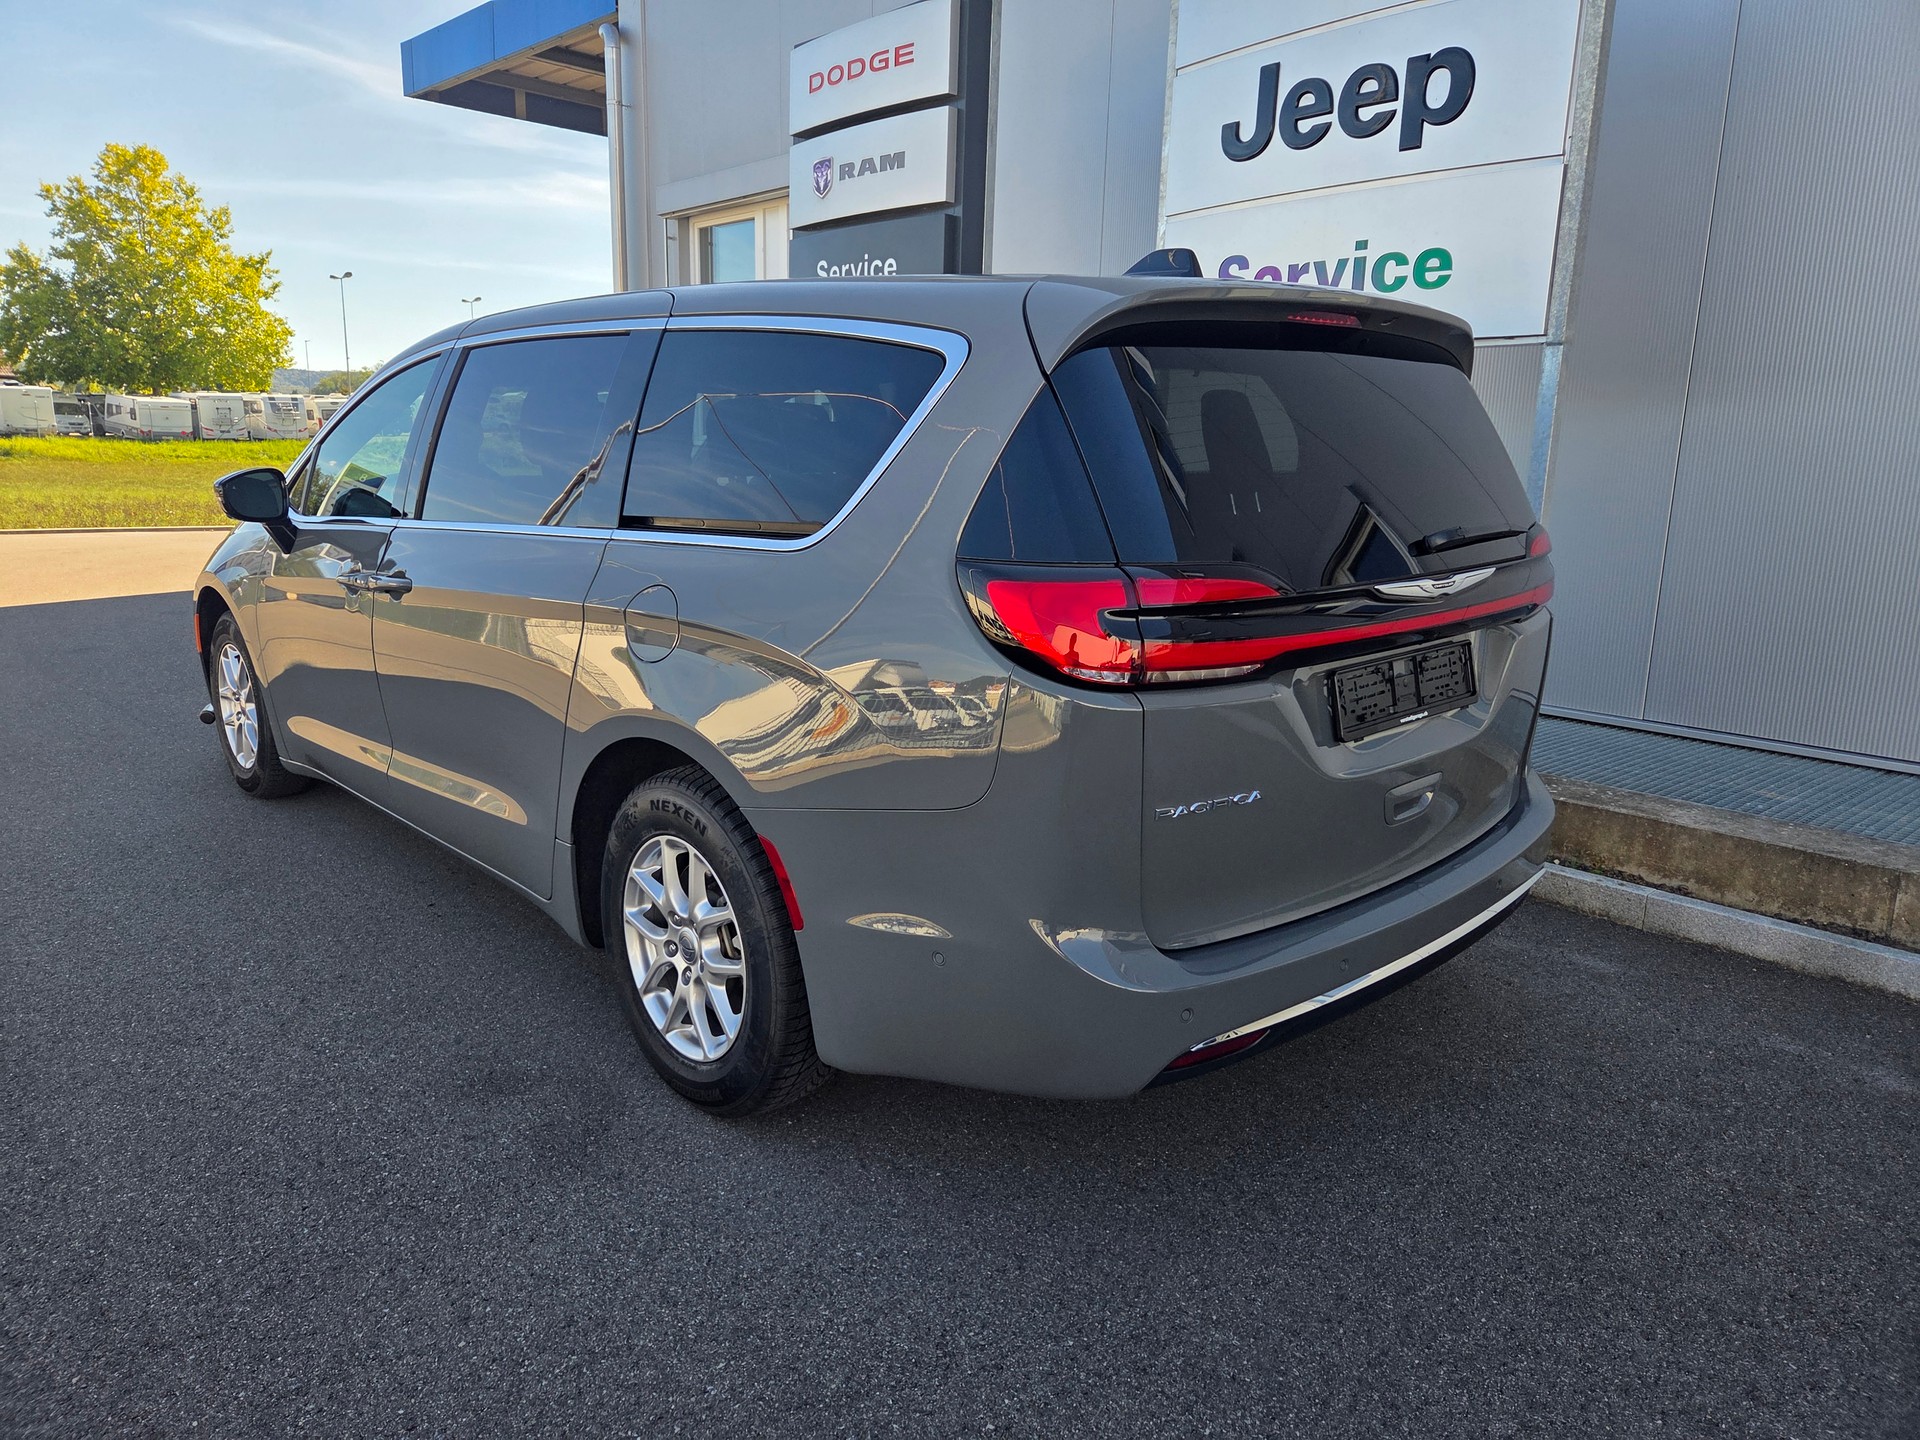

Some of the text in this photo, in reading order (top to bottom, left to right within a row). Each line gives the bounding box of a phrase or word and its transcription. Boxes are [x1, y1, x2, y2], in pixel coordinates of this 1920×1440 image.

[808, 42, 916, 94] DODGE
[1221, 46, 1476, 162] Jeep
[839, 151, 906, 181] RAM
[816, 253, 897, 277] Service
[649, 799, 708, 838] NEXEN
[1154, 790, 1262, 820] PACIFICA
